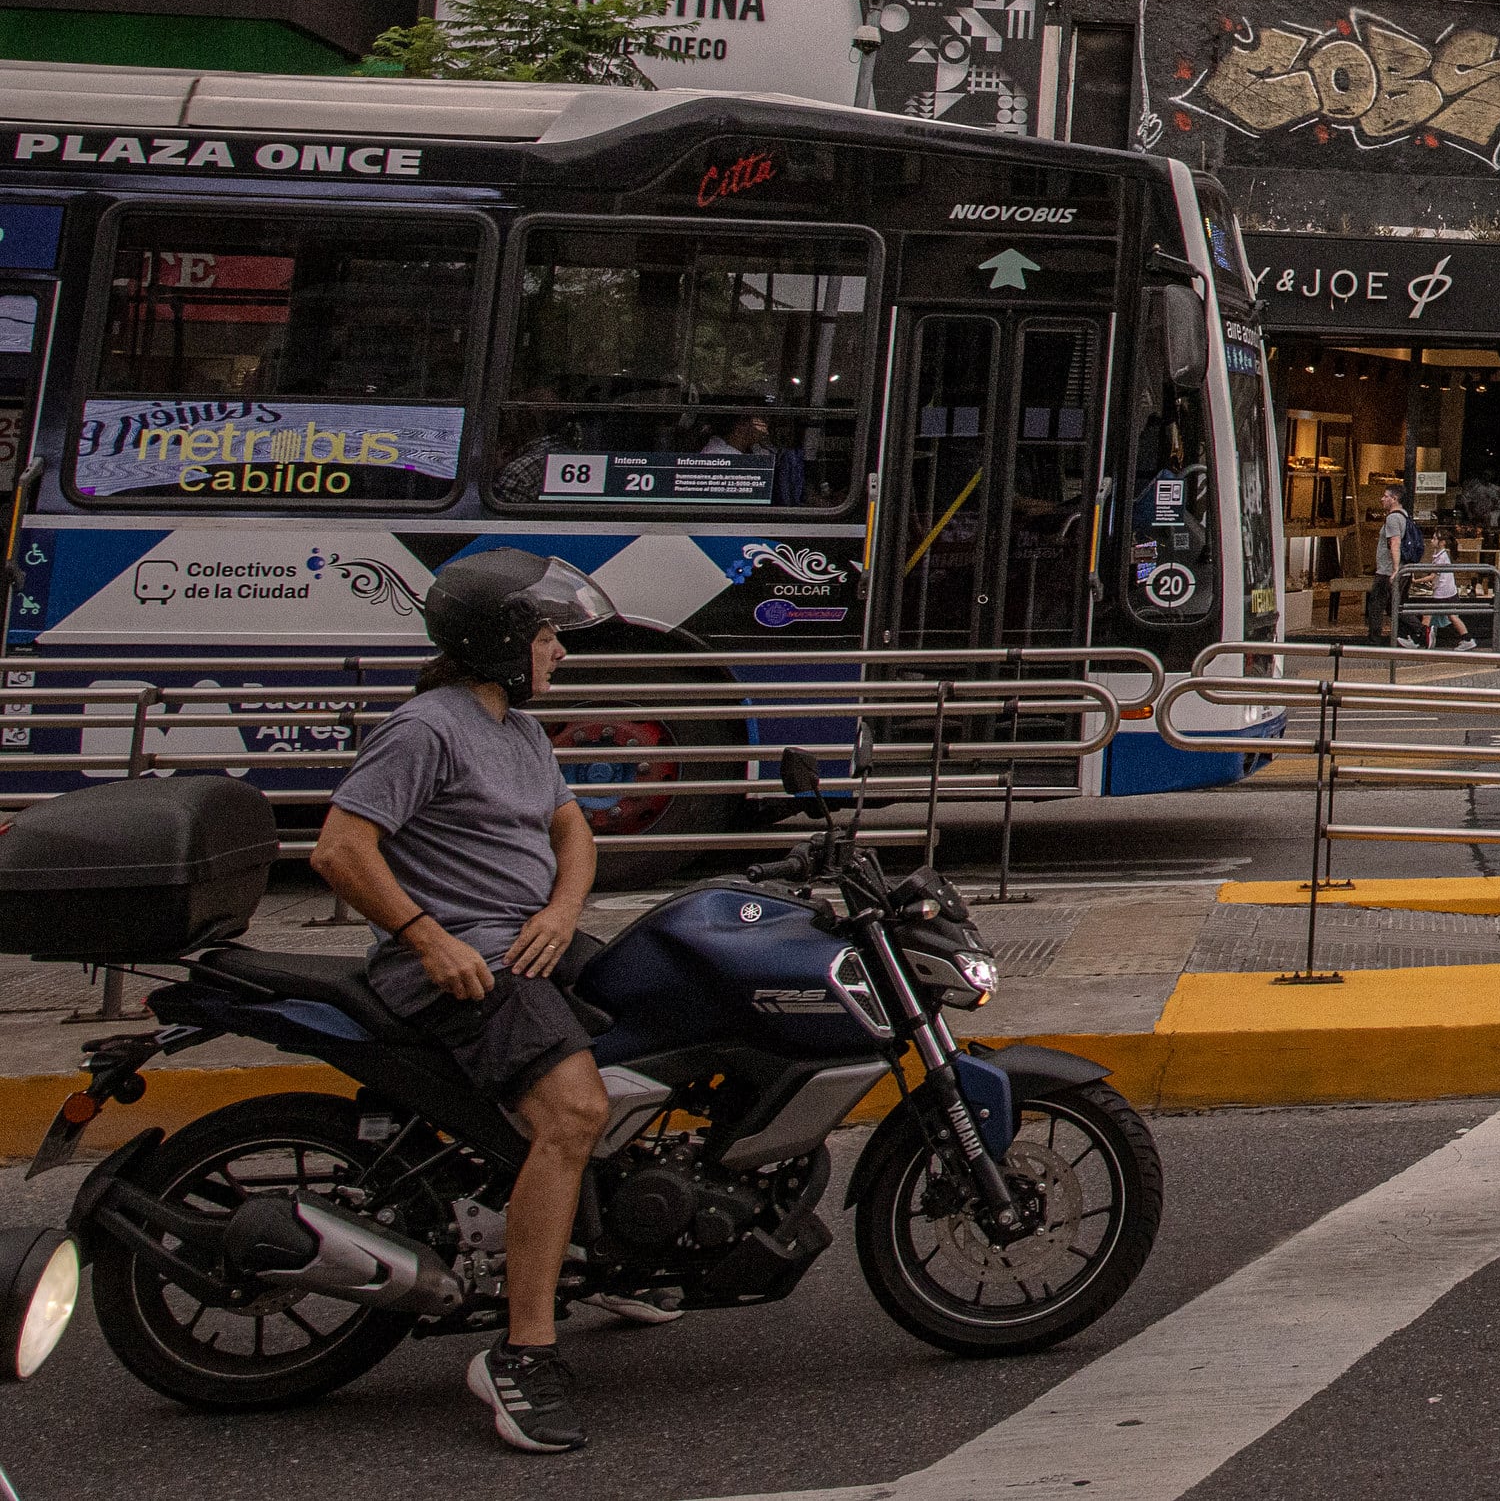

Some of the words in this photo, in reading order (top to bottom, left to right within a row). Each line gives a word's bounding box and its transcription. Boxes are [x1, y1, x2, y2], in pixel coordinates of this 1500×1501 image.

[668, 35, 728, 61] DECO
[14, 133, 236, 169] PLAZA
[255, 142, 423, 176] ONCE
[949, 203, 1077, 225] NUOVOBUS
[1276, 268, 1295, 292] &
[1302, 268, 1390, 301] JOE
[614, 456, 648, 465] Interno
[676, 456, 732, 467] Información
[178, 464, 351, 494] Cabildo
[560, 463, 592, 484] 68
[625, 473, 655, 491] 20
[186, 561, 299, 579] Colectivos
[184, 584, 210, 600] de
[212, 584, 233, 600] la
[235, 583, 311, 601] Ciudad
[773, 585, 831, 596] COLCAR
[1158, 575, 1183, 596] 20
[947, 1099, 984, 1161] YAMAHA
